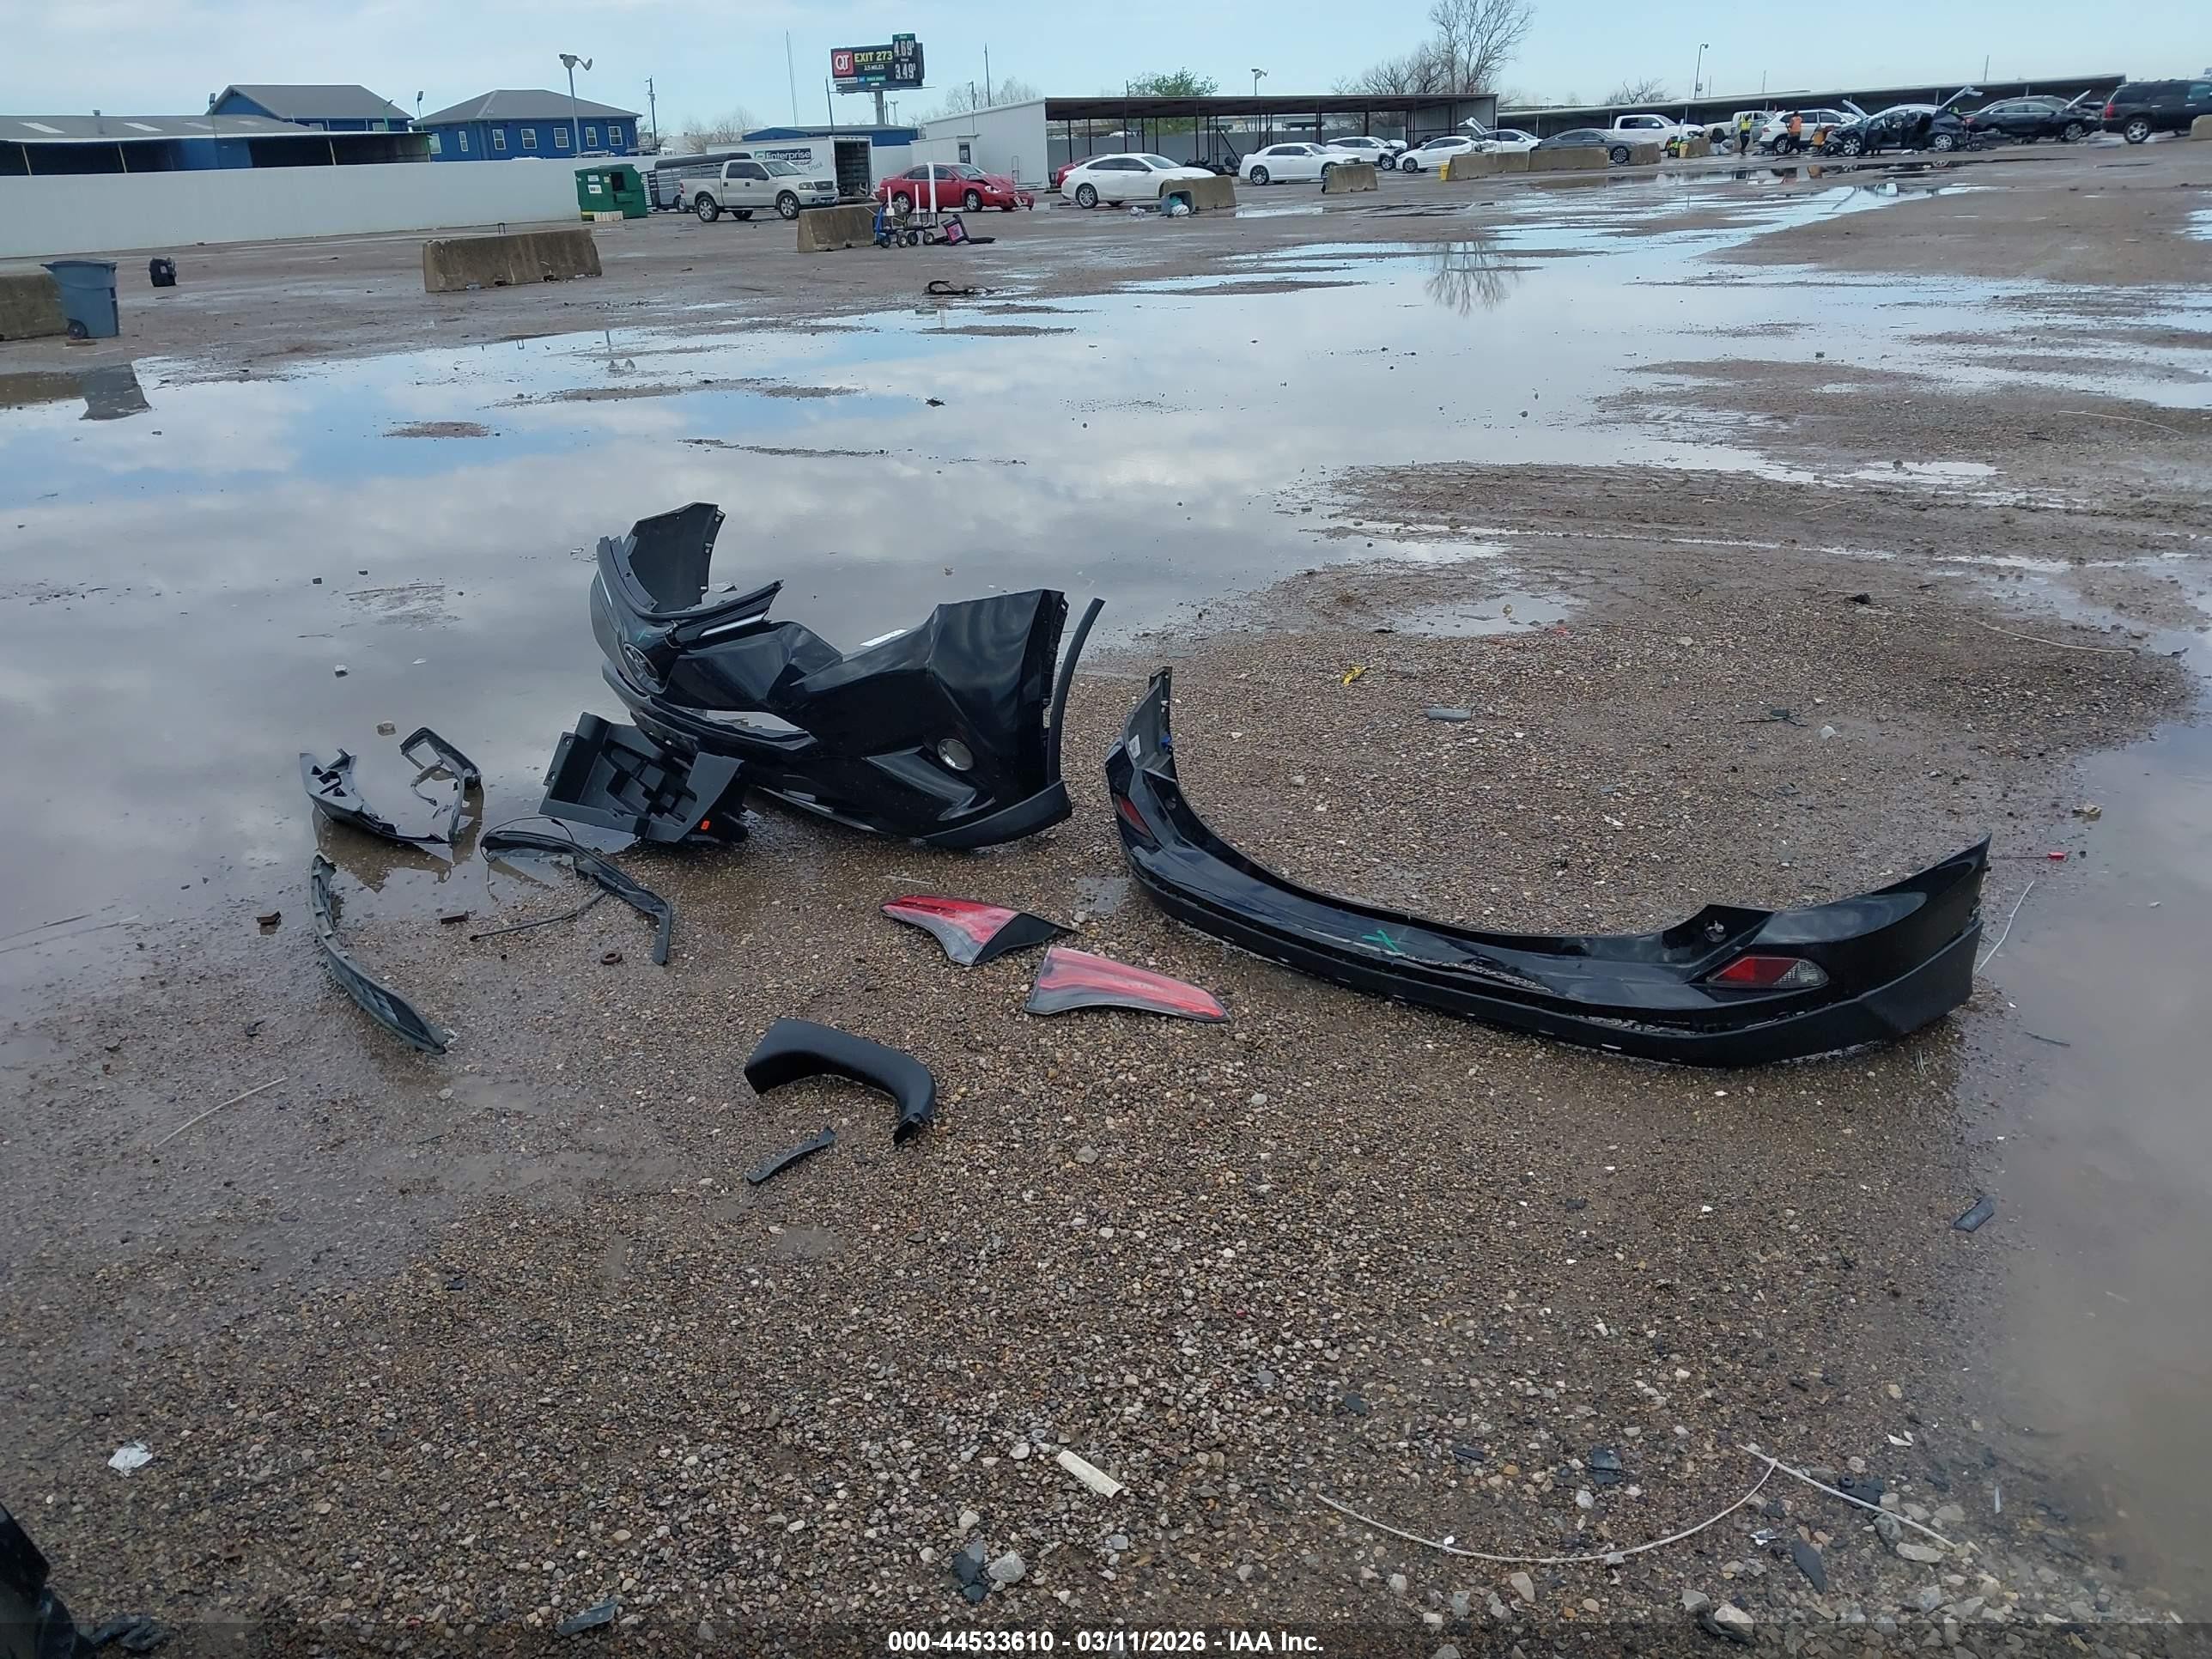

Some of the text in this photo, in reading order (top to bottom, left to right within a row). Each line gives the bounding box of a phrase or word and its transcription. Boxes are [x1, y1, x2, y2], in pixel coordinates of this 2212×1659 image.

[835, 55, 849, 70] QT
[854, 52, 873, 63] EXIT
[876, 51, 893, 61] 273
[766, 150, 811, 161] Enterprise
